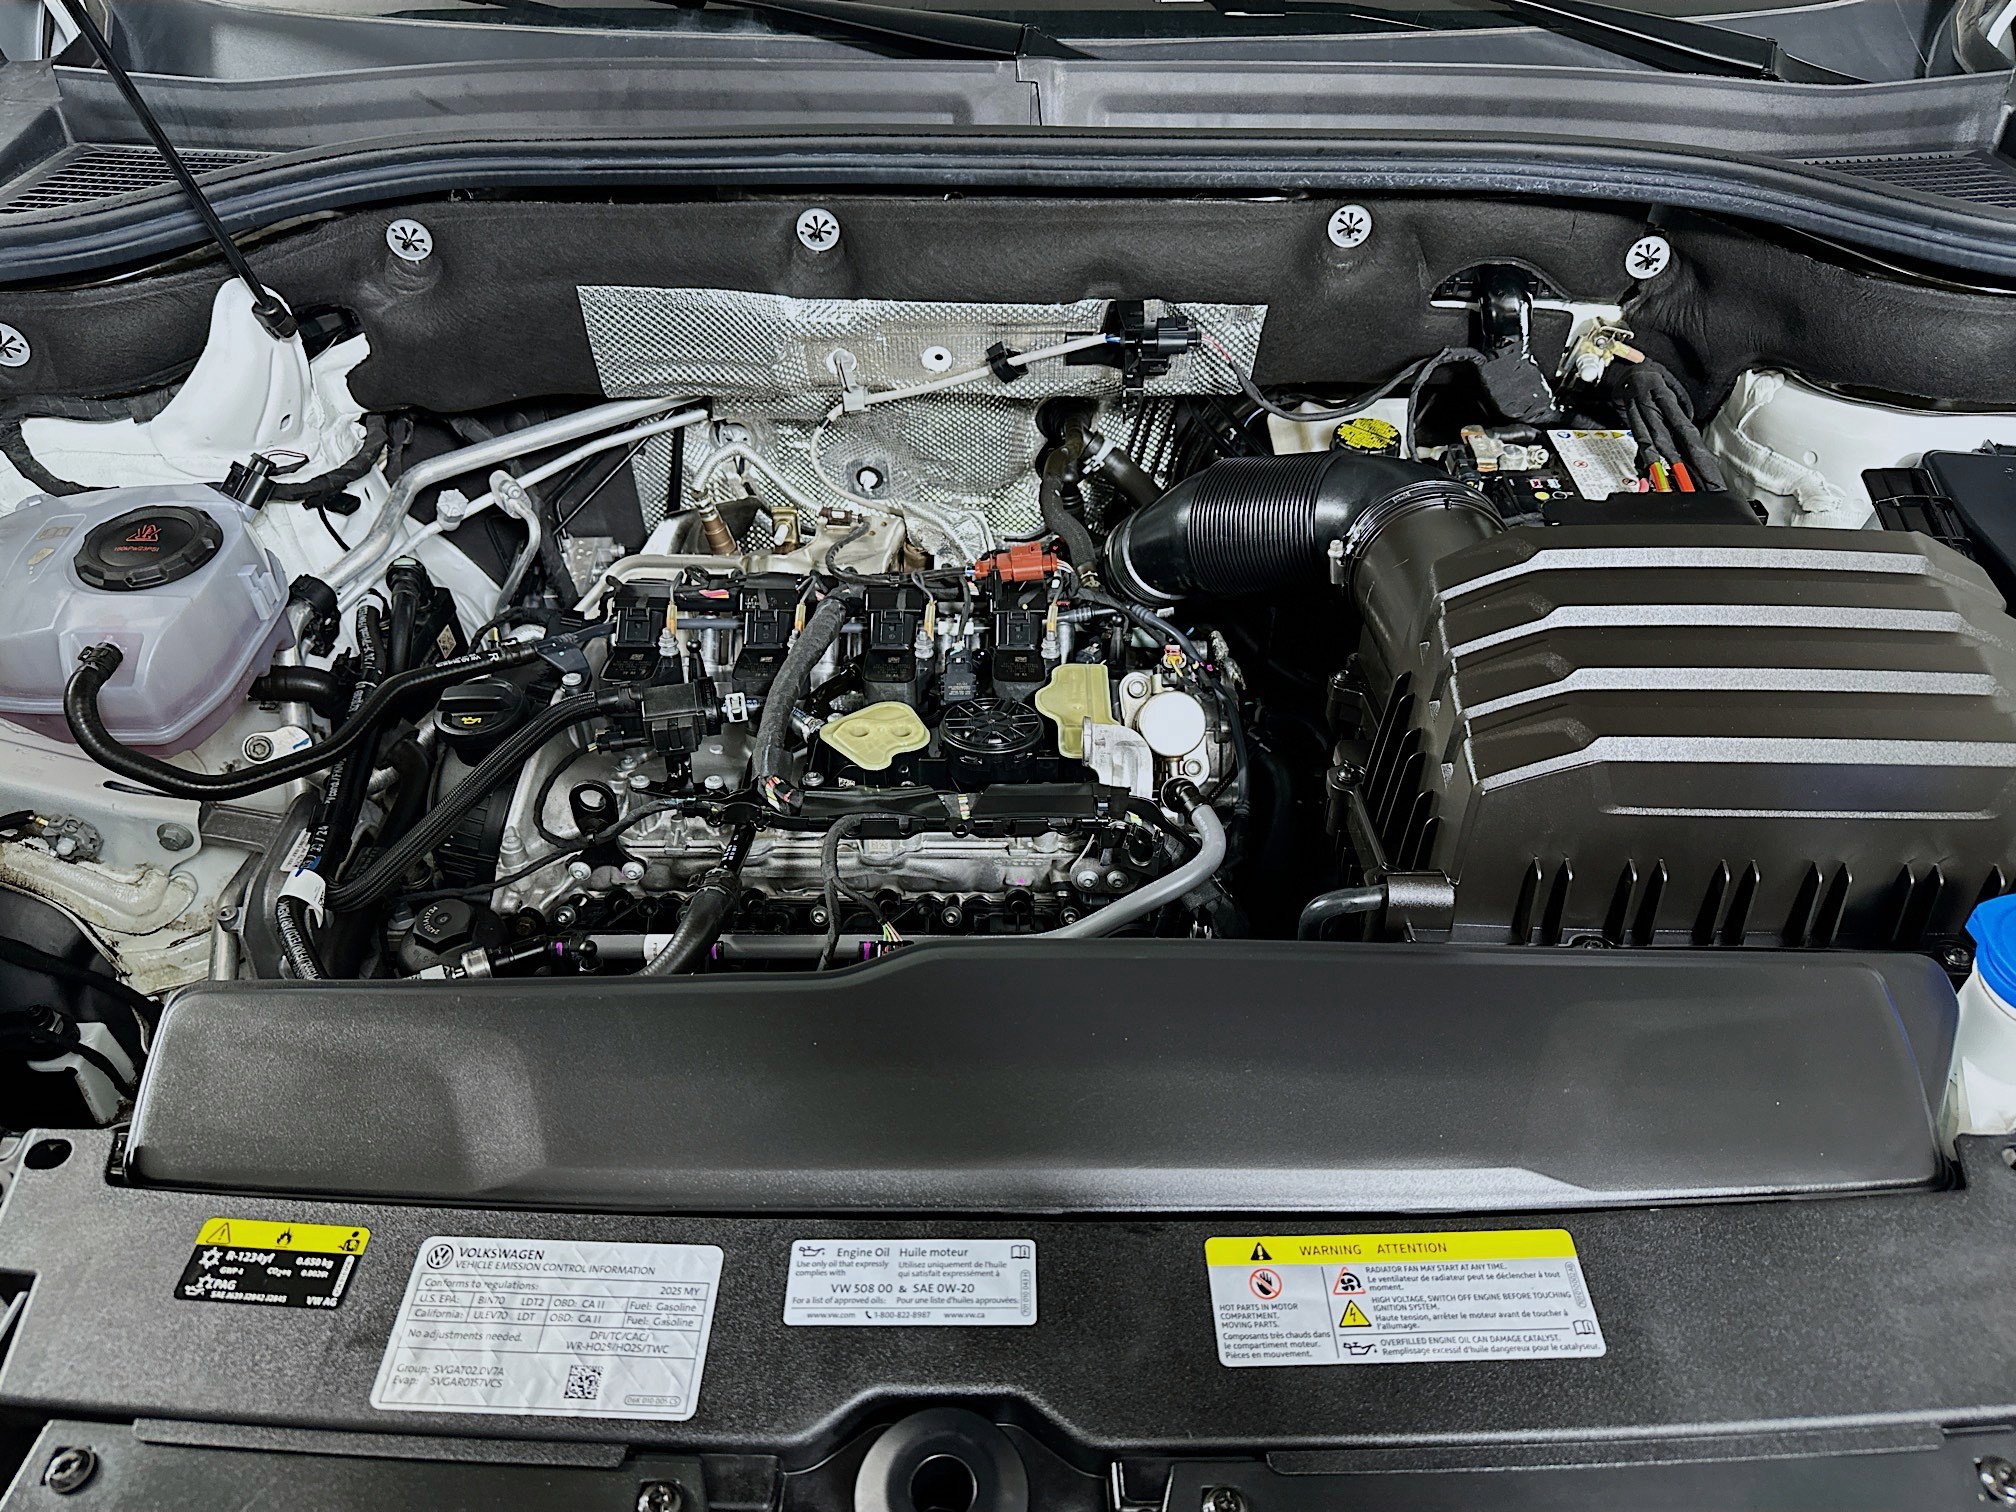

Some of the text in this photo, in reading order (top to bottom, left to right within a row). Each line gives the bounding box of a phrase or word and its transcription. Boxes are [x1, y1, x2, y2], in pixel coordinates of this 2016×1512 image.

[460, 1247, 545, 1260] VOLKSWAGEN
[837, 1247, 890, 1259] Engine Oil
[899, 1247, 969, 1257] Huile moteur
[1299, 1242, 1448, 1256] WARNING ATTENTION
[456, 1260, 656, 1275] VEHICLE EMISSION CONTROL INFORMATION
[797, 1260, 810, 1268] Use
[811, 1260, 827, 1269] only
[855, 1260, 889, 1269] expressly
[898, 1261, 926, 1269] Utilisez
[927, 1261, 972, 1270] uniquement
[795, 1269, 827, 1278] complies
[898, 1270, 910, 1278] qui
[942, 1270, 994, 1279] expressément
[1467, 1273, 1484, 1281] peut
[1496, 1271, 1536, 1280] déclencher
[425, 1278, 539, 1291] Conforms to regulations:
[831, 1283, 975, 1293] VW 508 00 & SAE 0W-20
[660, 1286, 700, 1296] 2025 MY
[792, 1296, 804, 1304] For
[812, 1296, 823, 1304] list
[825, 1296, 833, 1304] of
[834, 1296, 869, 1305] approved
[896, 1296, 913, 1304] Pour
[930, 1296, 945, 1304] liste
[946, 1296, 974, 1304] d'huiles
[975, 1296, 1019, 1305] approuvées.
[1391, 1295, 1426, 1303] VOLTAGE,
[1427, 1294, 1456, 1302] SWITCH
[1473, 1293, 1501, 1301] ENGINE
[1503, 1292, 1531, 1300] BEFORE
[1533, 1291, 1571, 1299] TOUCHING
[581, 1299, 596, 1308] CA
[630, 1301, 652, 1311] Fuel:
[656, 1302, 697, 1312] Gasoline
[1236, 1303, 1260, 1311] PARTS
[1408, 1303, 1440, 1311] SYSTEM.
[415, 1308, 464, 1319] California:
[517, 1312, 536, 1321] LDT
[578, 1314, 593, 1323] CA
[626, 1316, 649, 1326] Fuel:
[653, 1317, 695, 1327] Gasoline
[1220, 1312, 1280, 1320] COMPARTMENT.
[1400, 1313, 1431, 1321] tension,
[1432, 1312, 1458, 1320] arrêter
[1532, 1309, 1562, 1317] toucher
[408, 1329, 523, 1342] No adjustments needed.
[1223, 1332, 1269, 1341] Composants
[1270, 1331, 1283, 1339] très
[1233, 1341, 1288, 1350] compartiment
[1380, 1337, 1427, 1346] OVERFILLED
[1428, 1336, 1456, 1344] ENGINE
[1458, 1336, 1471, 1344] OIL
[1382, 1347, 1430, 1356] Remplissage
[1432, 1346, 1461, 1354] excessif
[1490, 1345, 1530, 1354] dangereux
[1532, 1344, 1549, 1353] pour
[1560, 1343, 1601, 1351] catalyseur.
[396, 1363, 430, 1375] Group:
